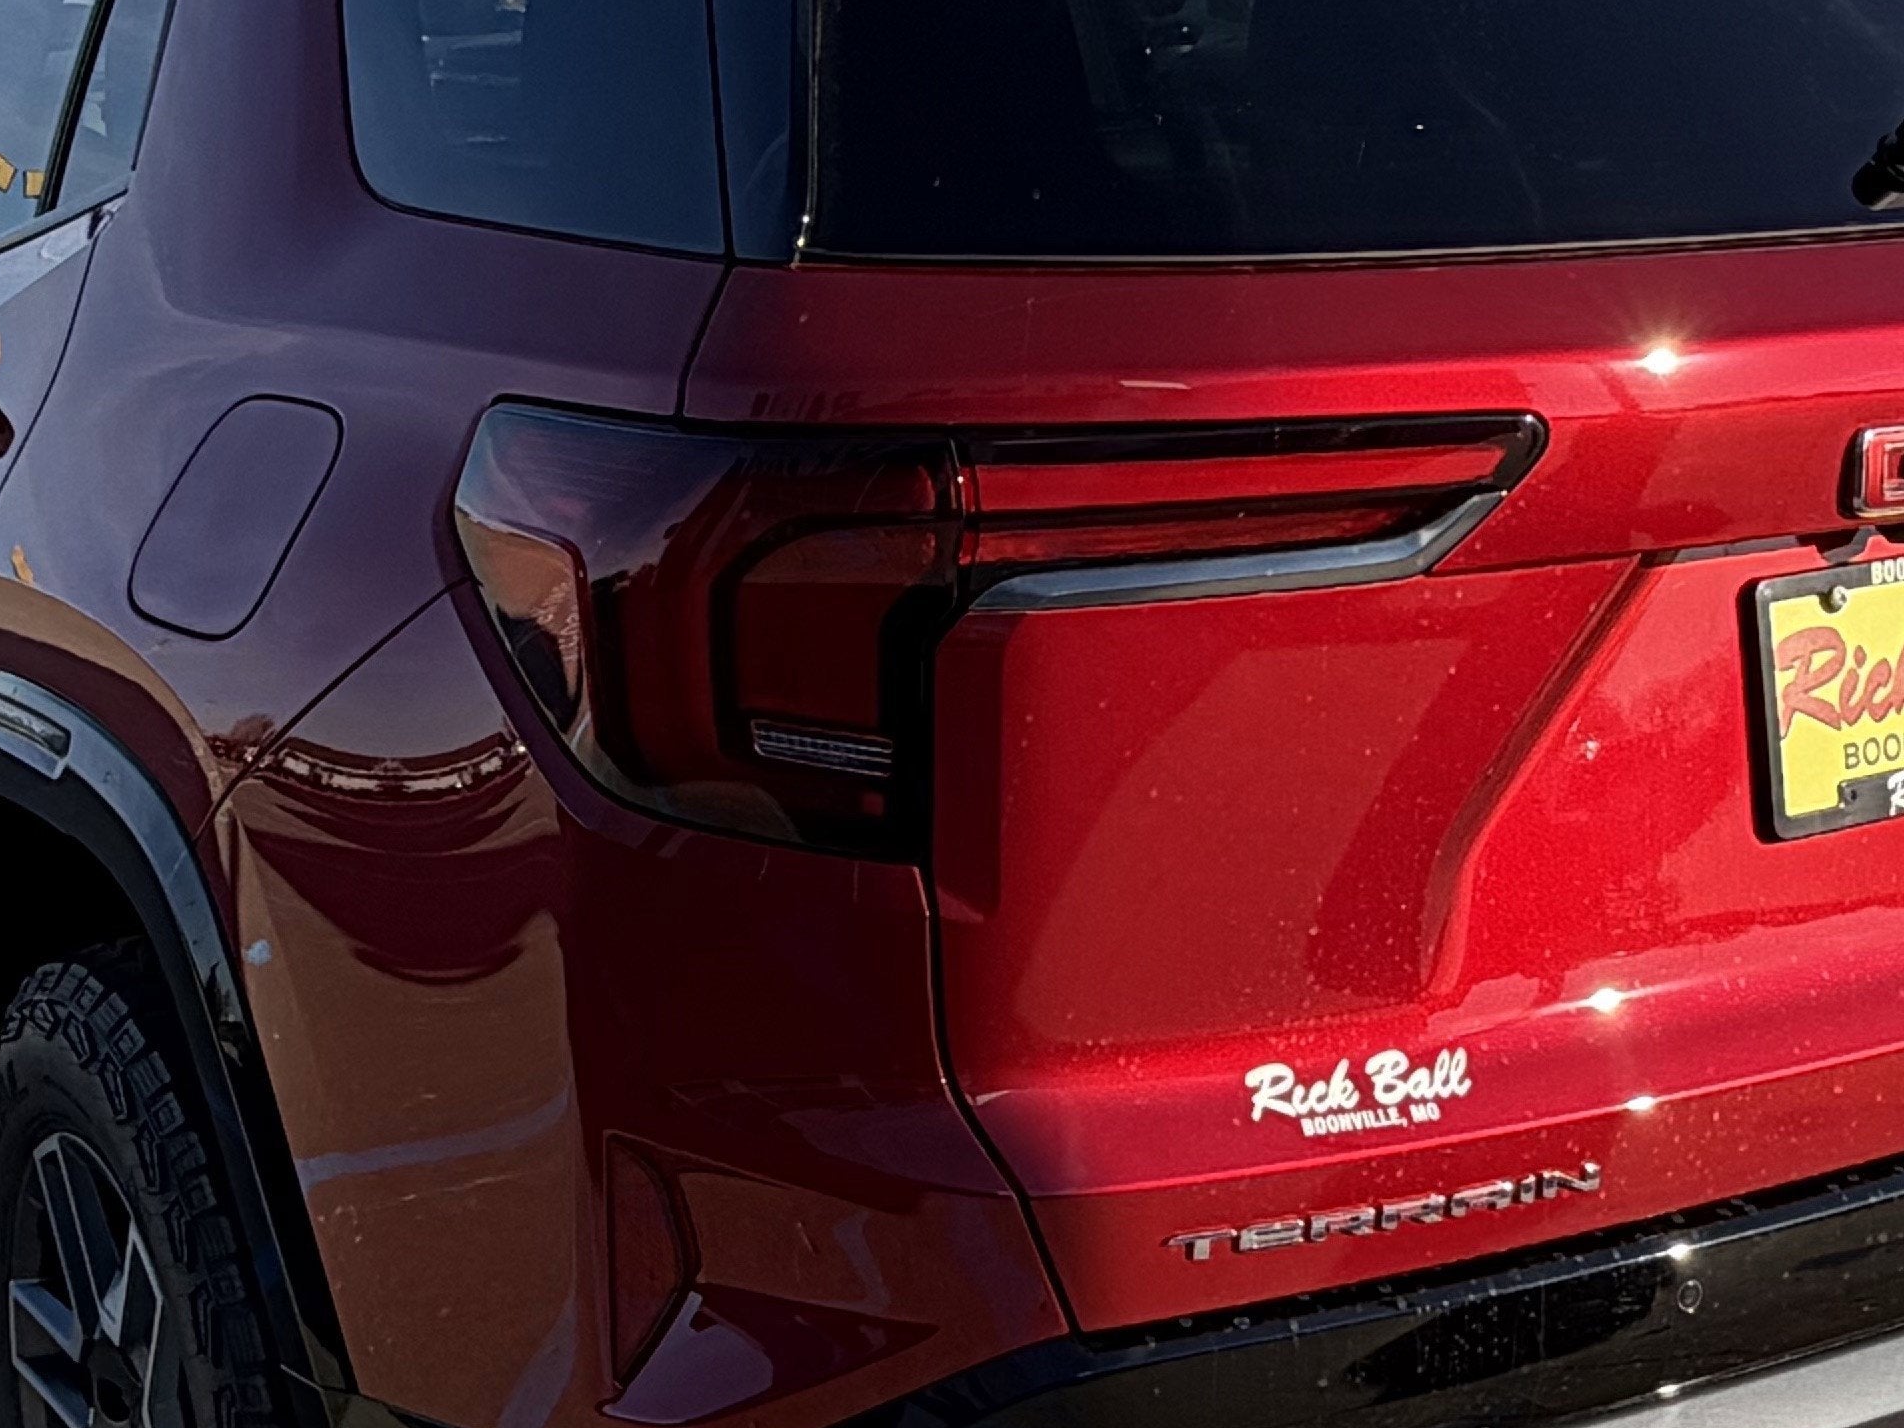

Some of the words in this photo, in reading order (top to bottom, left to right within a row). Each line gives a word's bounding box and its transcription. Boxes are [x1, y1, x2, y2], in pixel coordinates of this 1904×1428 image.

[1244, 1058, 1361, 1122] Rick
[1364, 1046, 1473, 1106] Ball
[1301, 1106, 1409, 1138] BOONVILLE,
[1410, 1101, 1442, 1123] MO
[1166, 1160, 1603, 1262] TERRAIN
